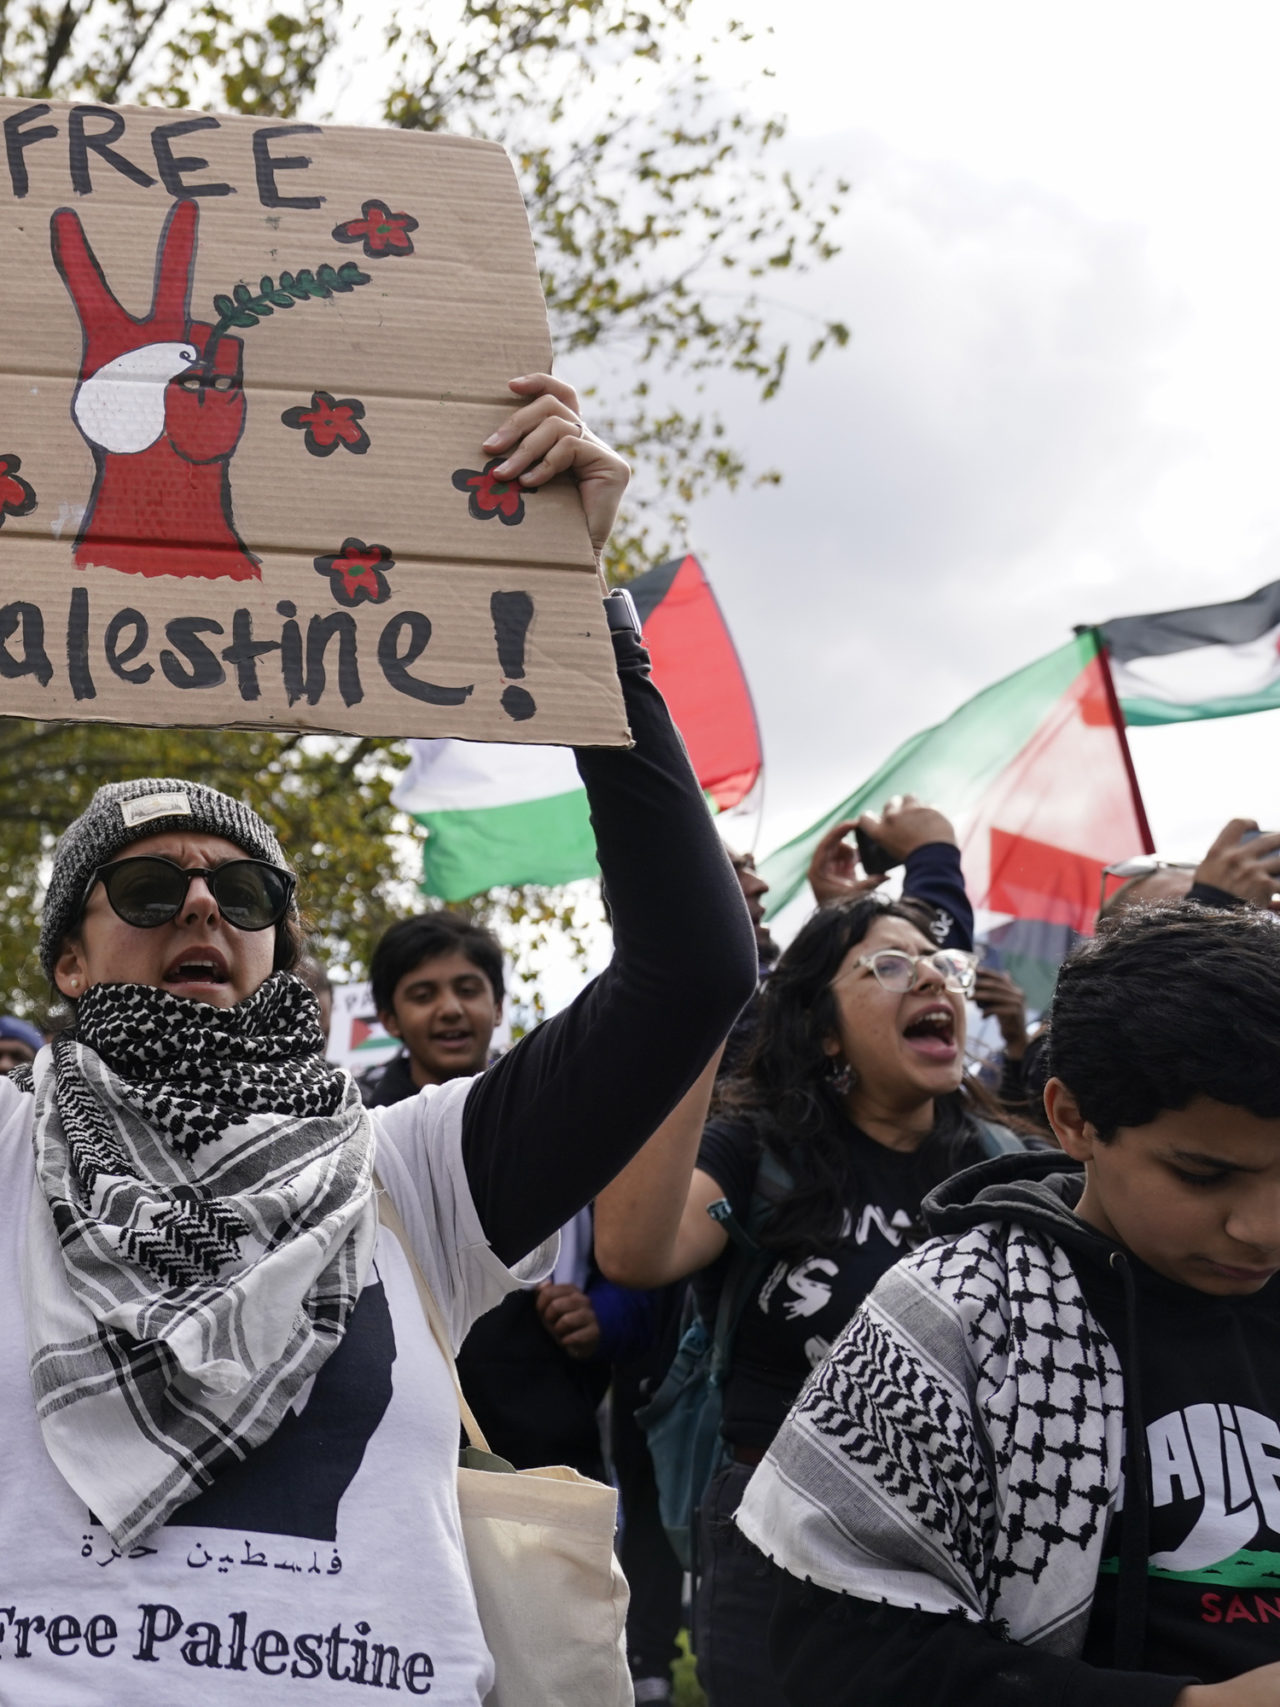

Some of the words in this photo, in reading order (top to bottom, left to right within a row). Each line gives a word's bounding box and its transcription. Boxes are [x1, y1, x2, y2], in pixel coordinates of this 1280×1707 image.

[3, 104, 326, 209] FREE
[186, 1539, 343, 1575] فلسطين
[131, 1603, 435, 1695] Palestine
